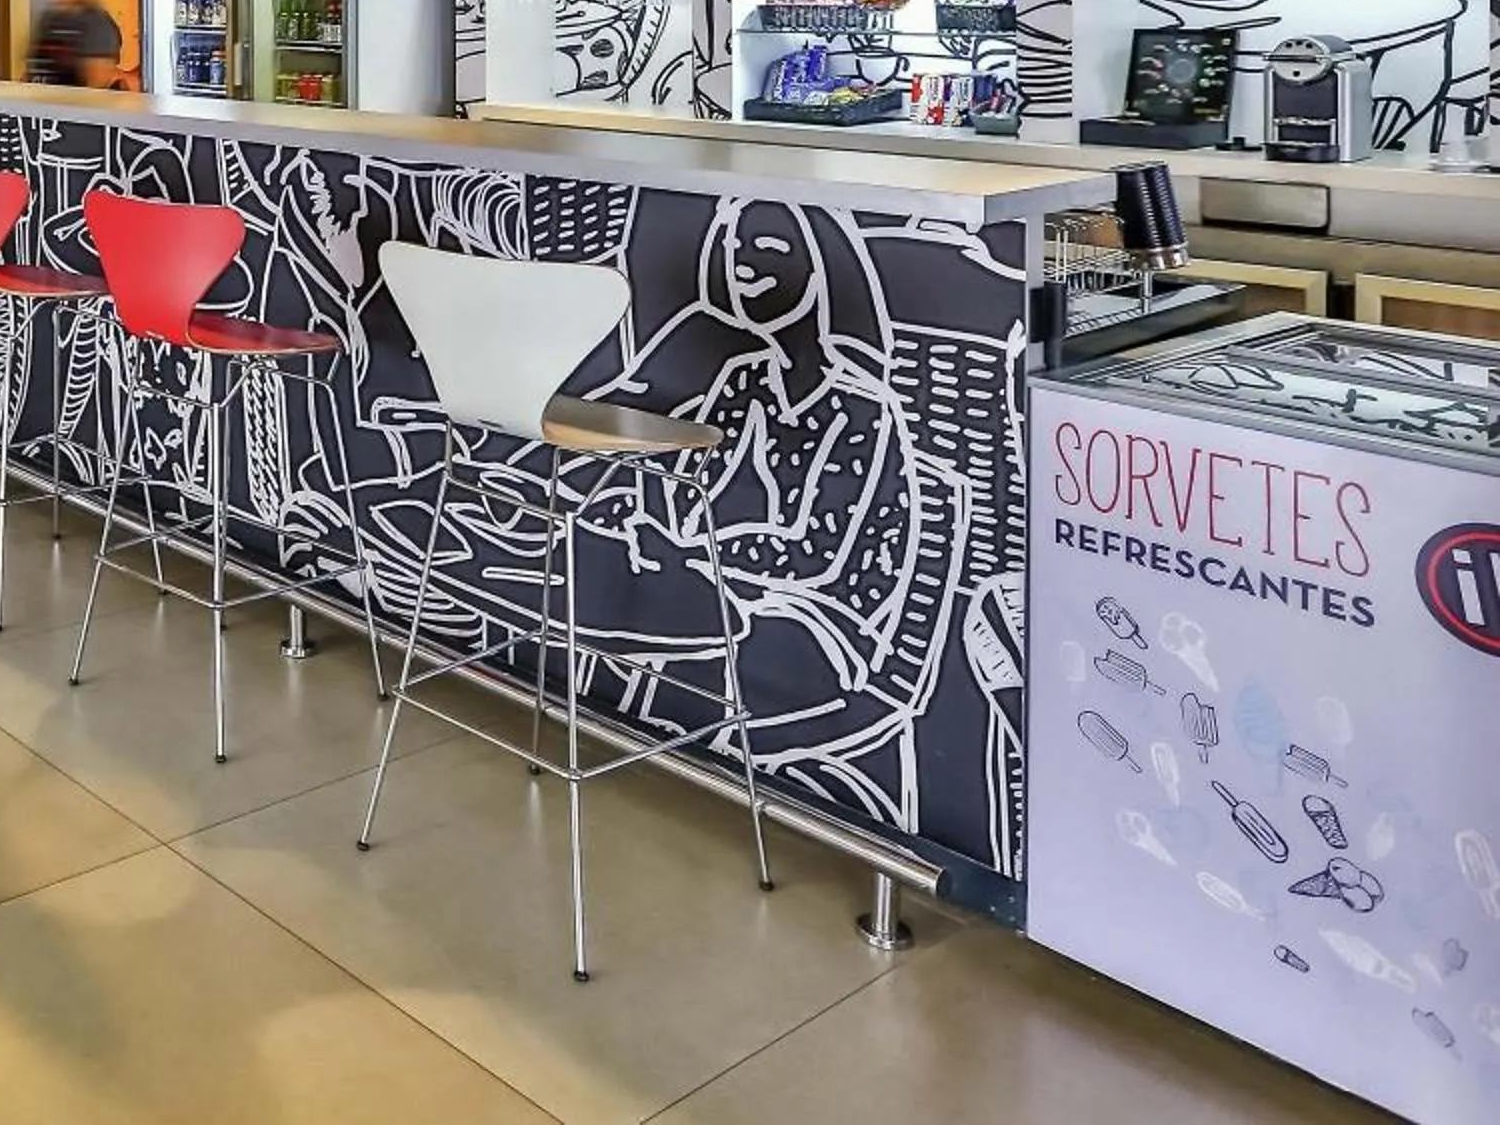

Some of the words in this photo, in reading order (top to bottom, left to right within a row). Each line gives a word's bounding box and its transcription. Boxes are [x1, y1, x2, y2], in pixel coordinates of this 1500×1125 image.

[1055, 422, 1371, 577] SORVETES
[1055, 518, 1376, 628] REFRESCANTES
[1452, 548, 1500, 626] i
